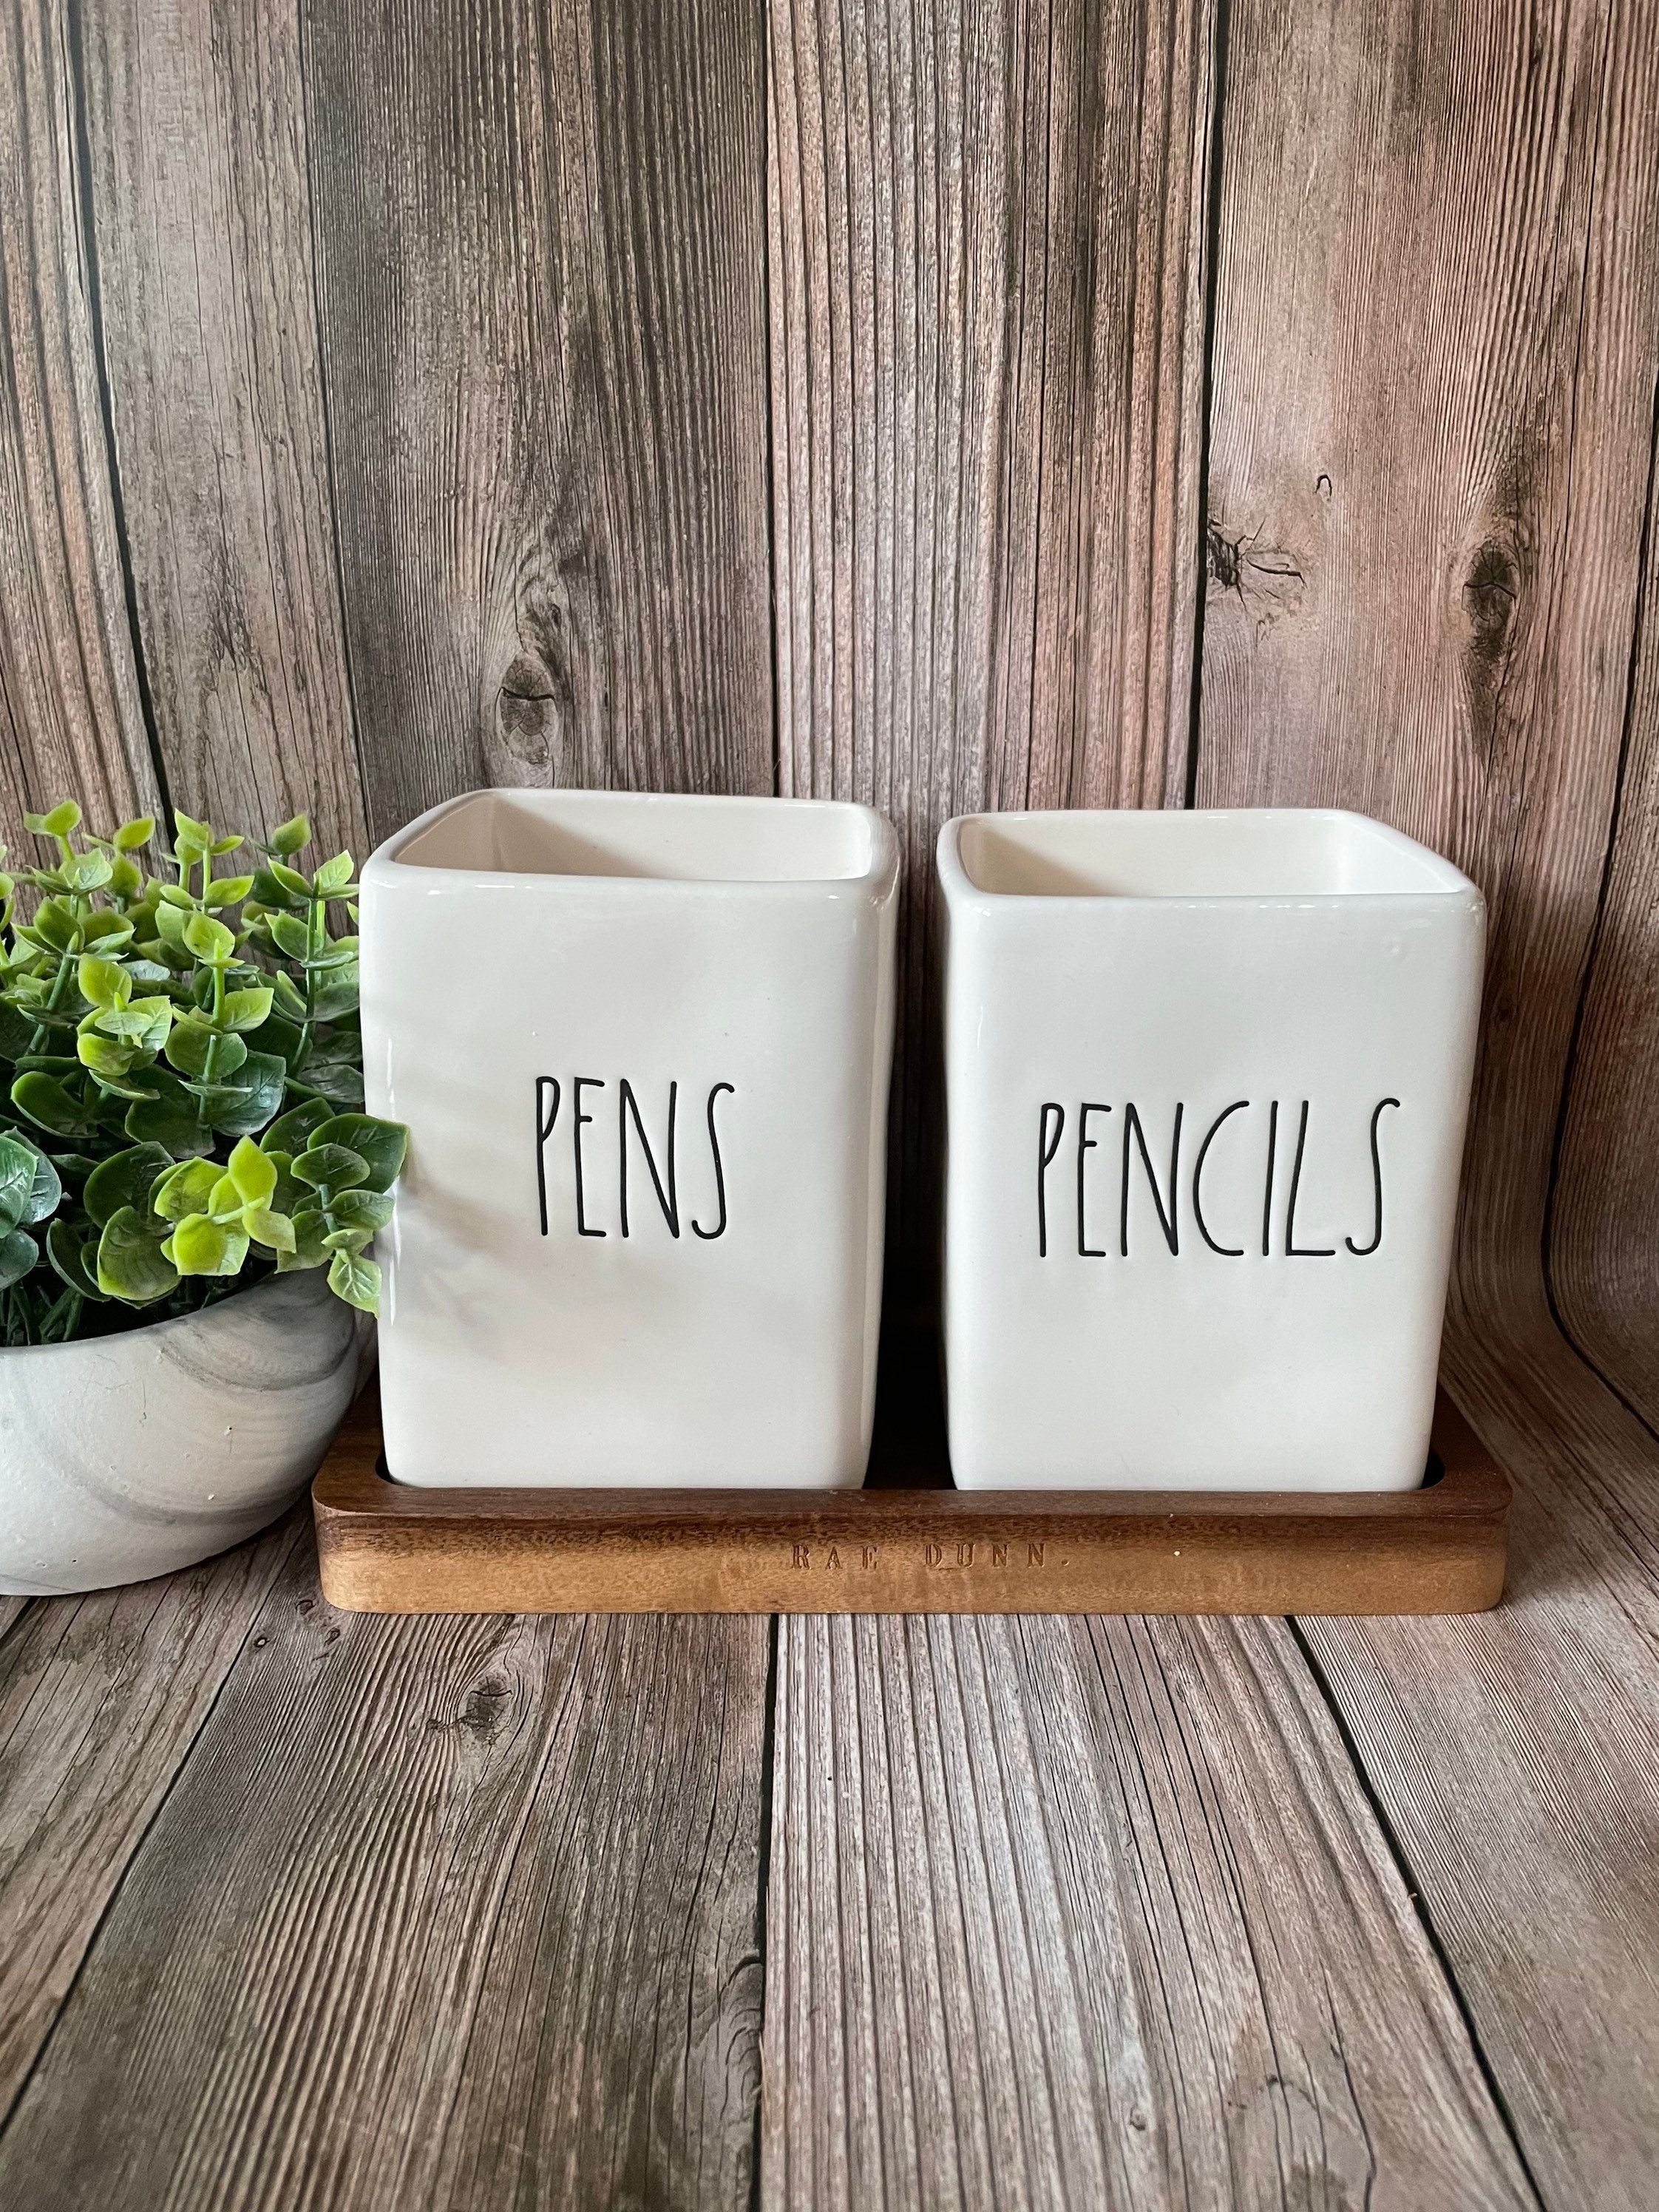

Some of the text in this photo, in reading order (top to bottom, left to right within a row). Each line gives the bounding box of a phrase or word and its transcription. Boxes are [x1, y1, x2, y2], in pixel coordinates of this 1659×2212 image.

[535, 1076, 735, 1240] PENS
[1037, 1097, 1401, 1258] PENCILS
[790, 1543, 878, 1570] RAE
